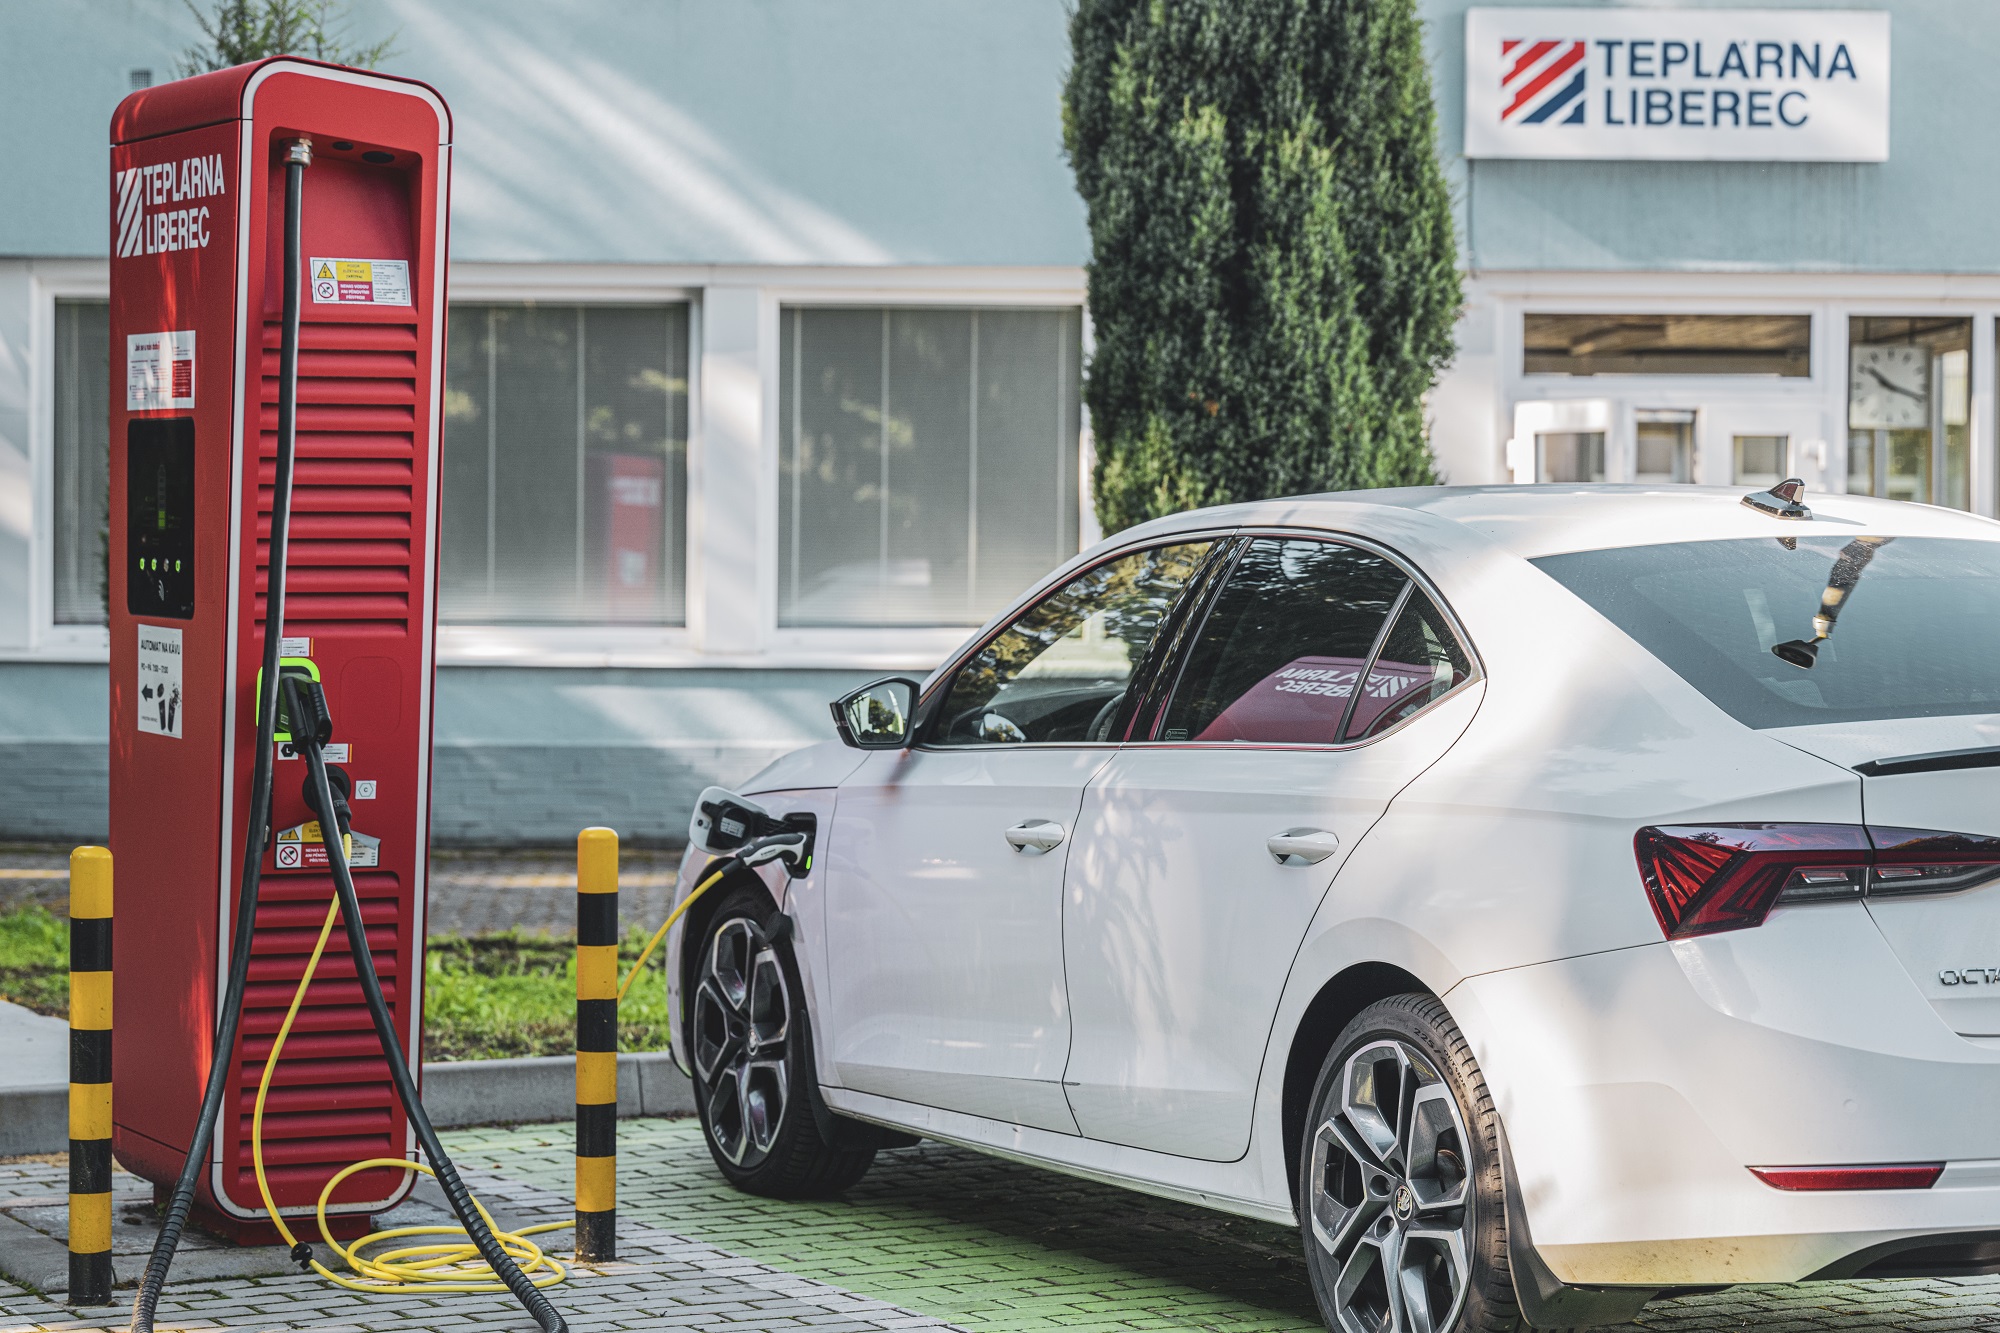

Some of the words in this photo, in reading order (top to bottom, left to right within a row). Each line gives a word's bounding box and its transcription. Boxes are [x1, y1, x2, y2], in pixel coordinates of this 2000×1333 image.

[1595, 38, 1857, 81] TEPLÁRNA
[1605, 88, 1809, 127] LIBEREC
[143, 153, 225, 205] TEPLÁRNA
[145, 205, 210, 253] LIBEREC
[141, 639, 162, 652] AUTOMAT
[161, 642, 168, 653] NA
[168, 640, 181, 655] KÁVU
[1413, 1027, 1454, 1076] 225/40
[1443, 1049, 1467, 1087] OUTSIDE
